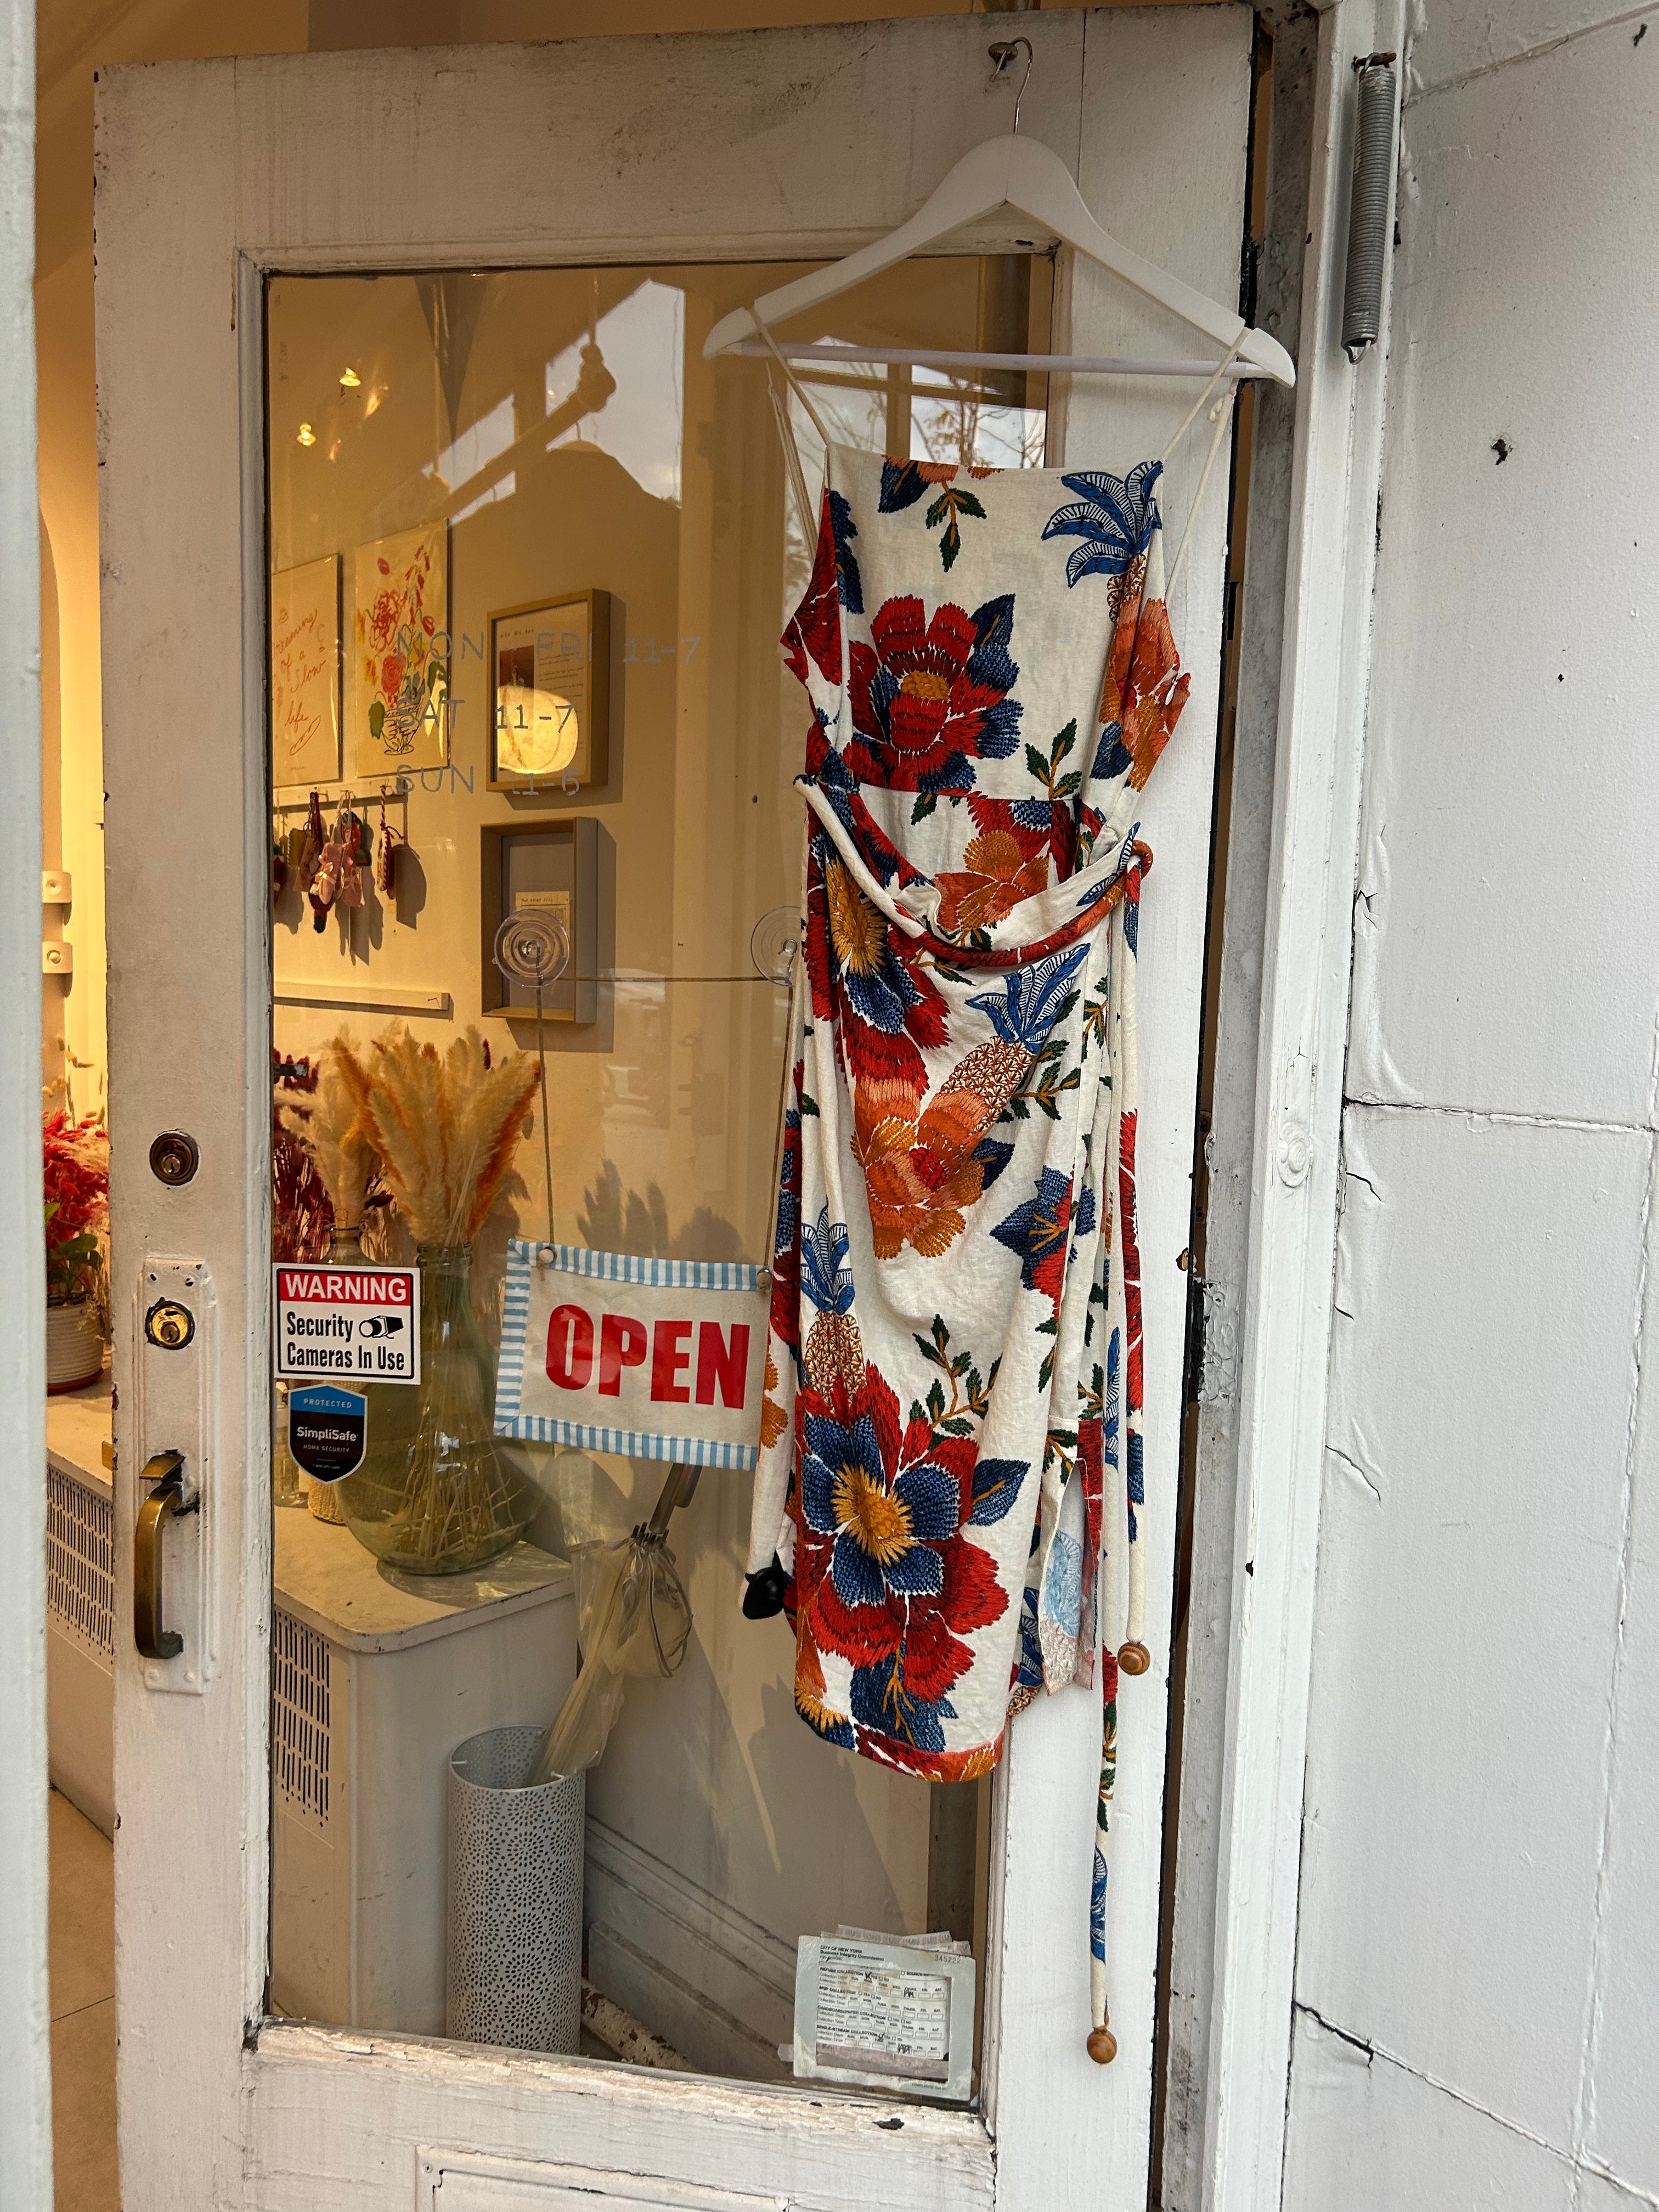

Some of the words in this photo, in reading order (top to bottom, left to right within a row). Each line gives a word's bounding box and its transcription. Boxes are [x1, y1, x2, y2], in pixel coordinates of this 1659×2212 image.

[397, 631, 484, 661] MON
[535, 632, 593, 663] FRI
[623, 636, 701, 667] 11-7
[395, 698, 465, 729] SAT
[495, 704, 574, 733] 11-7
[395, 764, 474, 794] SUN
[285, 1274, 407, 1302] WARNING
[287, 1311, 353, 1342] Security
[287, 1342, 353, 1369] Cameras
[358, 1345, 373, 1369] In
[378, 1346, 405, 1370] Use
[546, 1304, 751, 1409] OPEN
[303, 1398, 352, 1408] PROTECTED
[297, 1426, 357, 1442] SimpliSafe
[934, 1954, 961, 1964] 345222
